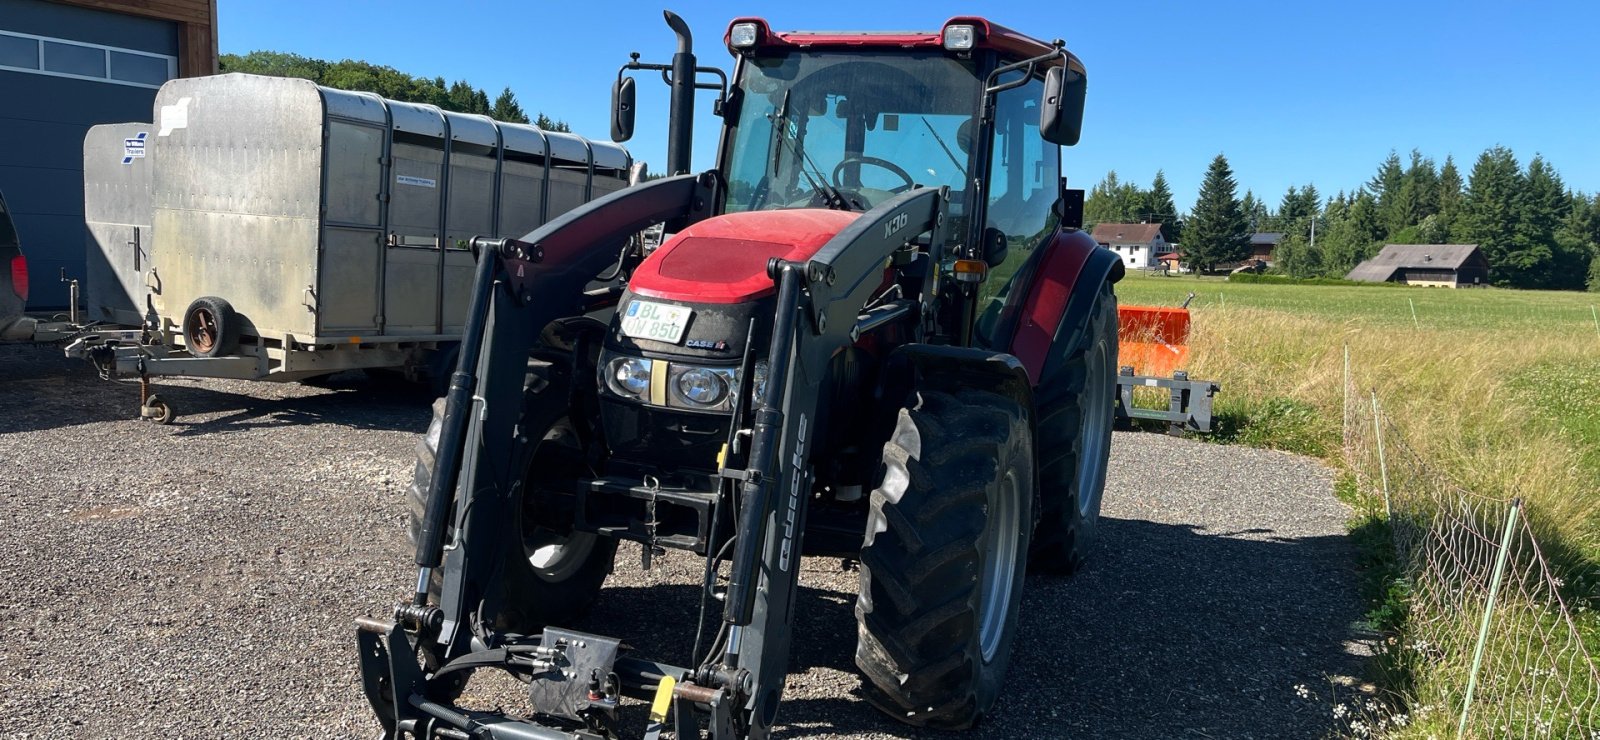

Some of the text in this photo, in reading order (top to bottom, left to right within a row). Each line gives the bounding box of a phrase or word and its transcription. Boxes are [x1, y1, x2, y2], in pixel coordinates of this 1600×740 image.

[640, 304, 661, 320] BL
[648, 321, 680, 340] 850
[686, 340, 713, 348] CASE
